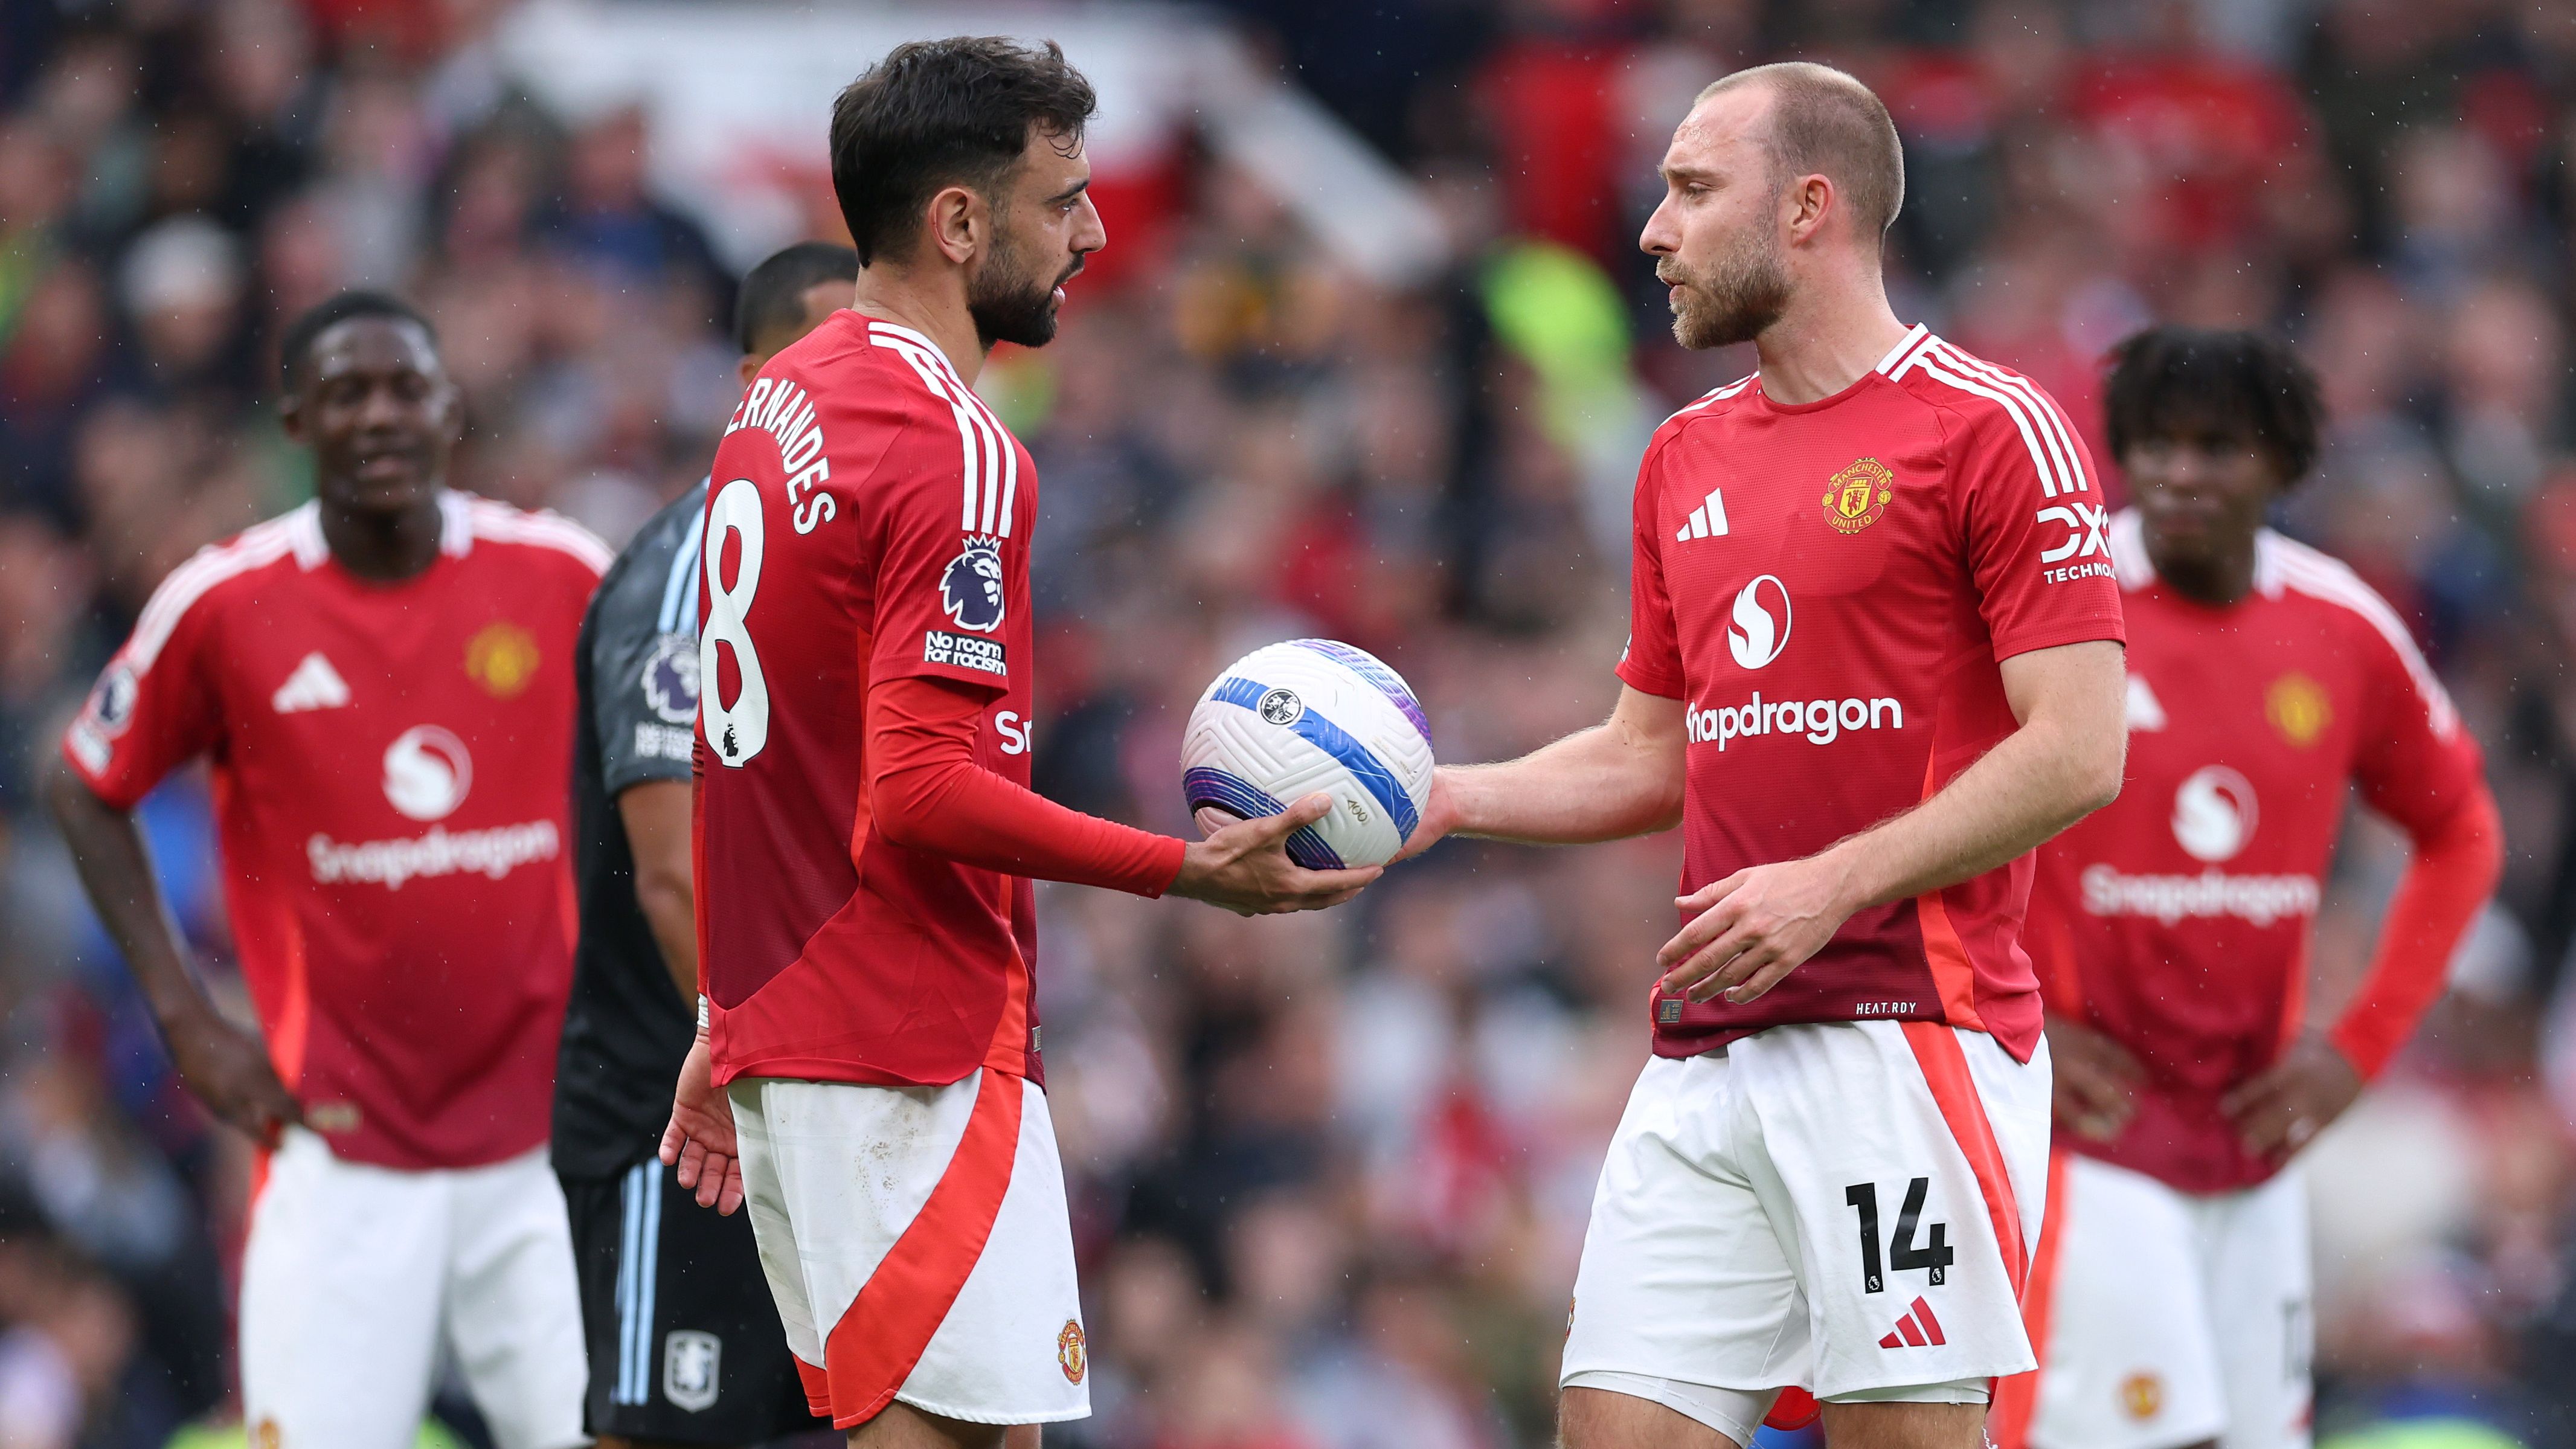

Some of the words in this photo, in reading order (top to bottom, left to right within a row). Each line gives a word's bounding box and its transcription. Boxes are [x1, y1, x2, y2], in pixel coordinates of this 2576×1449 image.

[724, 378, 837, 535] ERNANDES
[1832, 463, 1887, 488] MANCHESTER
[1832, 515, 1872, 529] UNITED
[699, 478, 769, 768] 8
[926, 631, 954, 649] No
[956, 637, 1002, 660] room
[924, 646, 952, 662] for
[952, 649, 1007, 676] racism
[1856, 1002, 1916, 1015] HEAT.RDY
[1846, 1177, 1953, 1294] 14
[1067, 1368, 1084, 1381] UNITED
